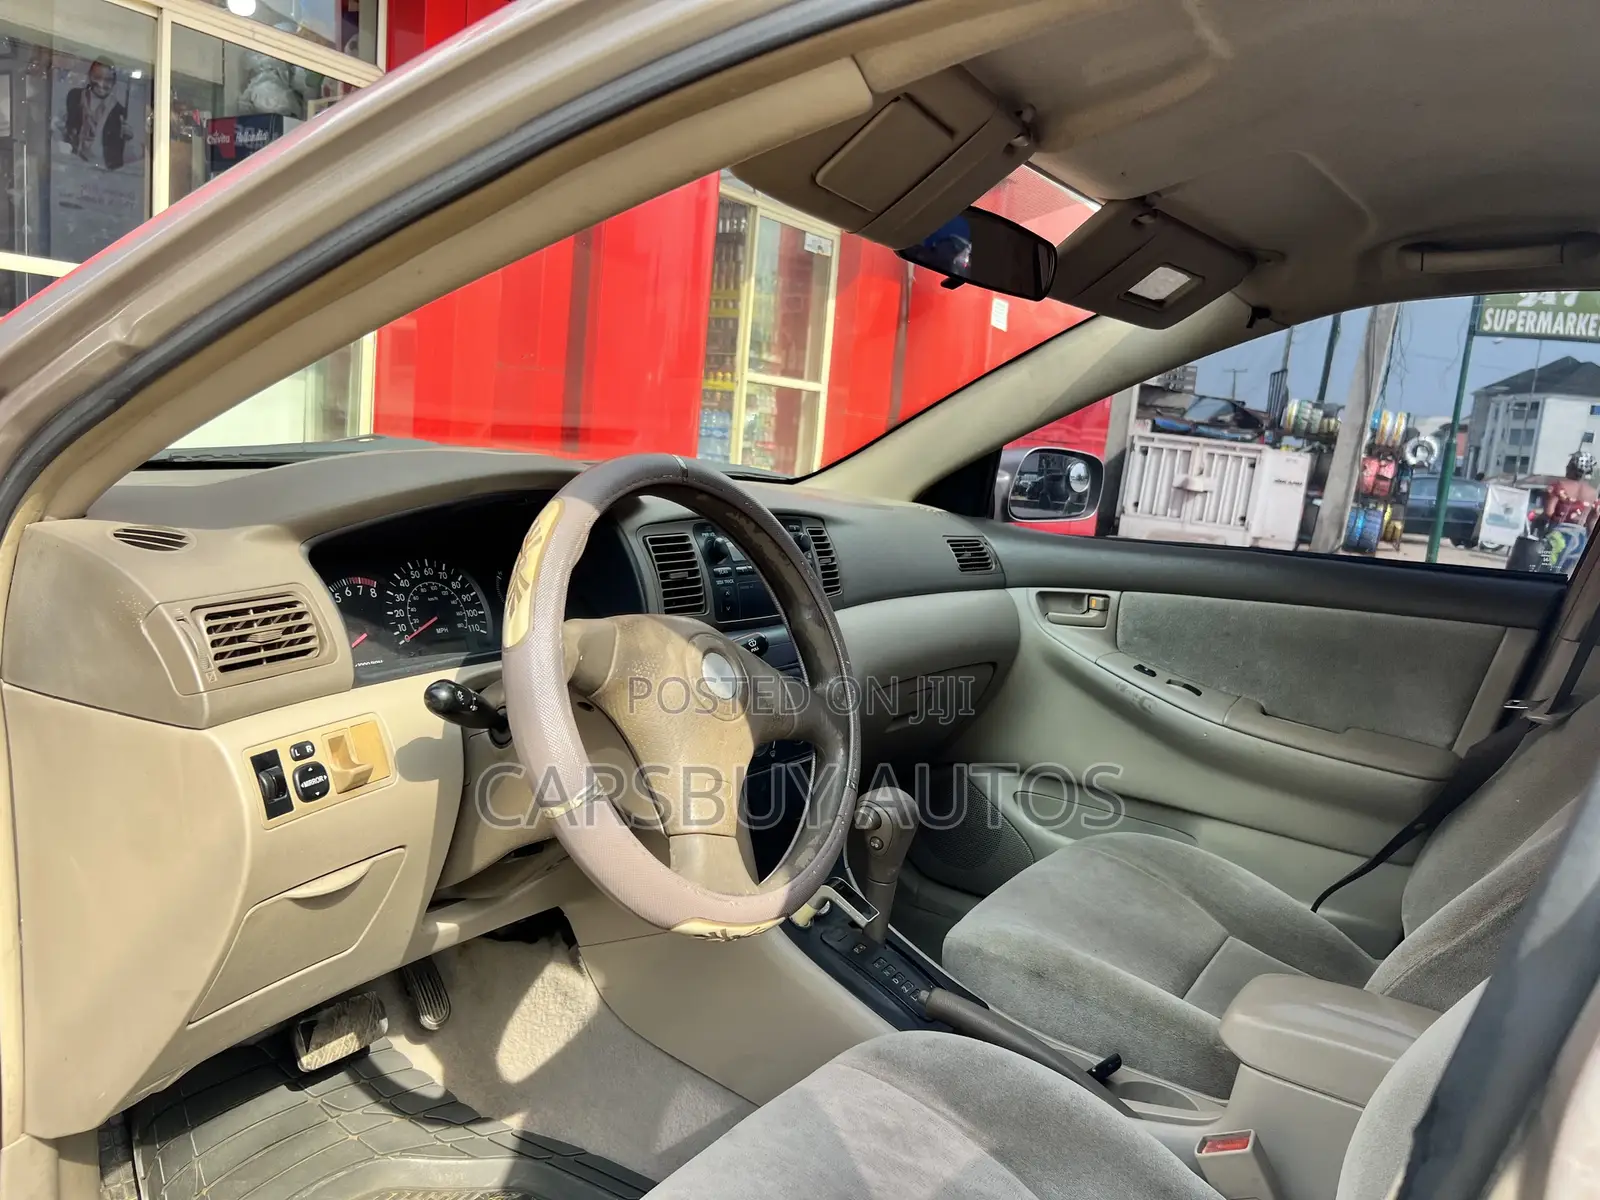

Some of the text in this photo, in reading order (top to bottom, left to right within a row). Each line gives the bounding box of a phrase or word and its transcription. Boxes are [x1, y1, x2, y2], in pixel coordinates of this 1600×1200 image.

[410, 570, 420, 578] 50
[424, 568, 434, 576] 60
[438, 572, 448, 580] 70
[451, 582, 461, 590] 80
[345, 586, 352, 596] 6
[357, 586, 362, 596] 7
[370, 588, 377, 598] 8
[334, 592, 342, 603] 5
[394, 594, 405, 602] 30
[394, 610, 404, 618] 20
[466, 609, 478, 617] 100
[398, 624, 406, 632] 10
[468, 624, 480, 632] 110
[304, 776, 324, 788] MIRROR
